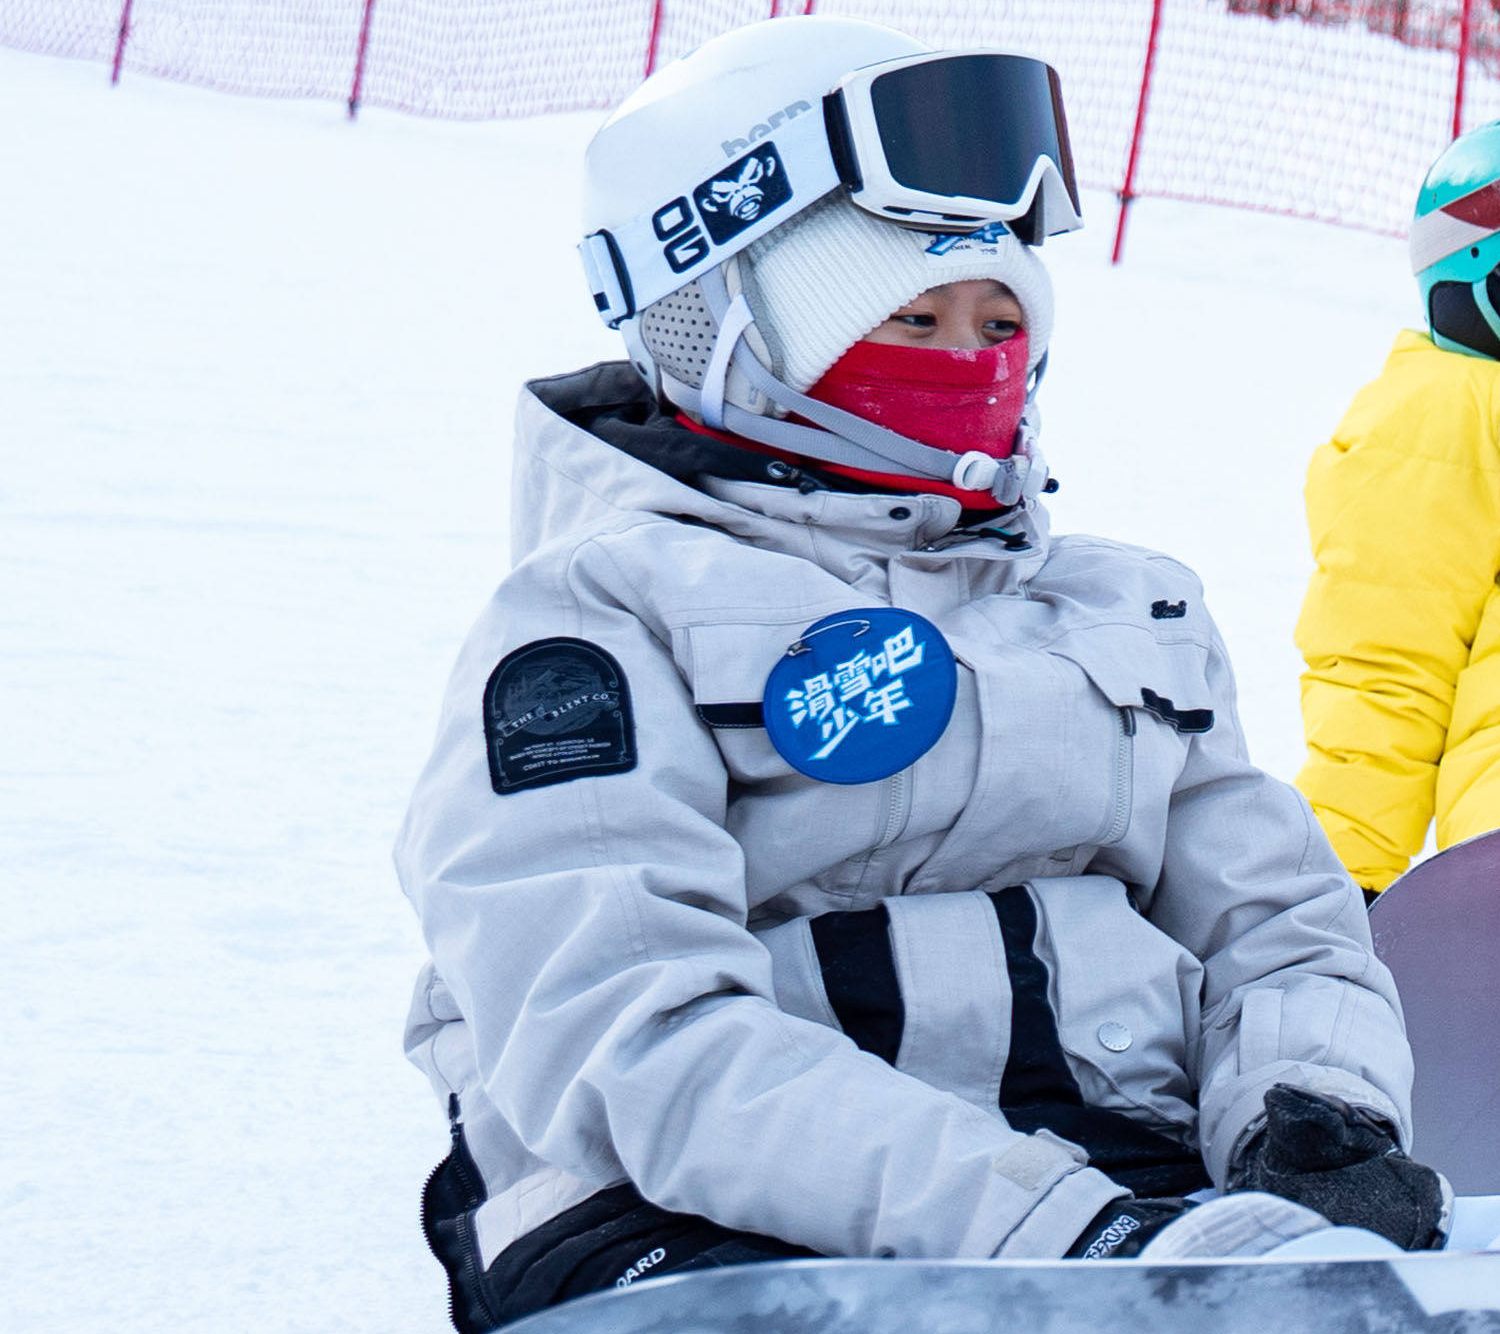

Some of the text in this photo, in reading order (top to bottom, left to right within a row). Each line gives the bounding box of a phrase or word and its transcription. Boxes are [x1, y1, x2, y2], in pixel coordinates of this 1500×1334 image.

[784, 624, 926, 729] 滑雪吧
[807, 676, 914, 761] 少年
